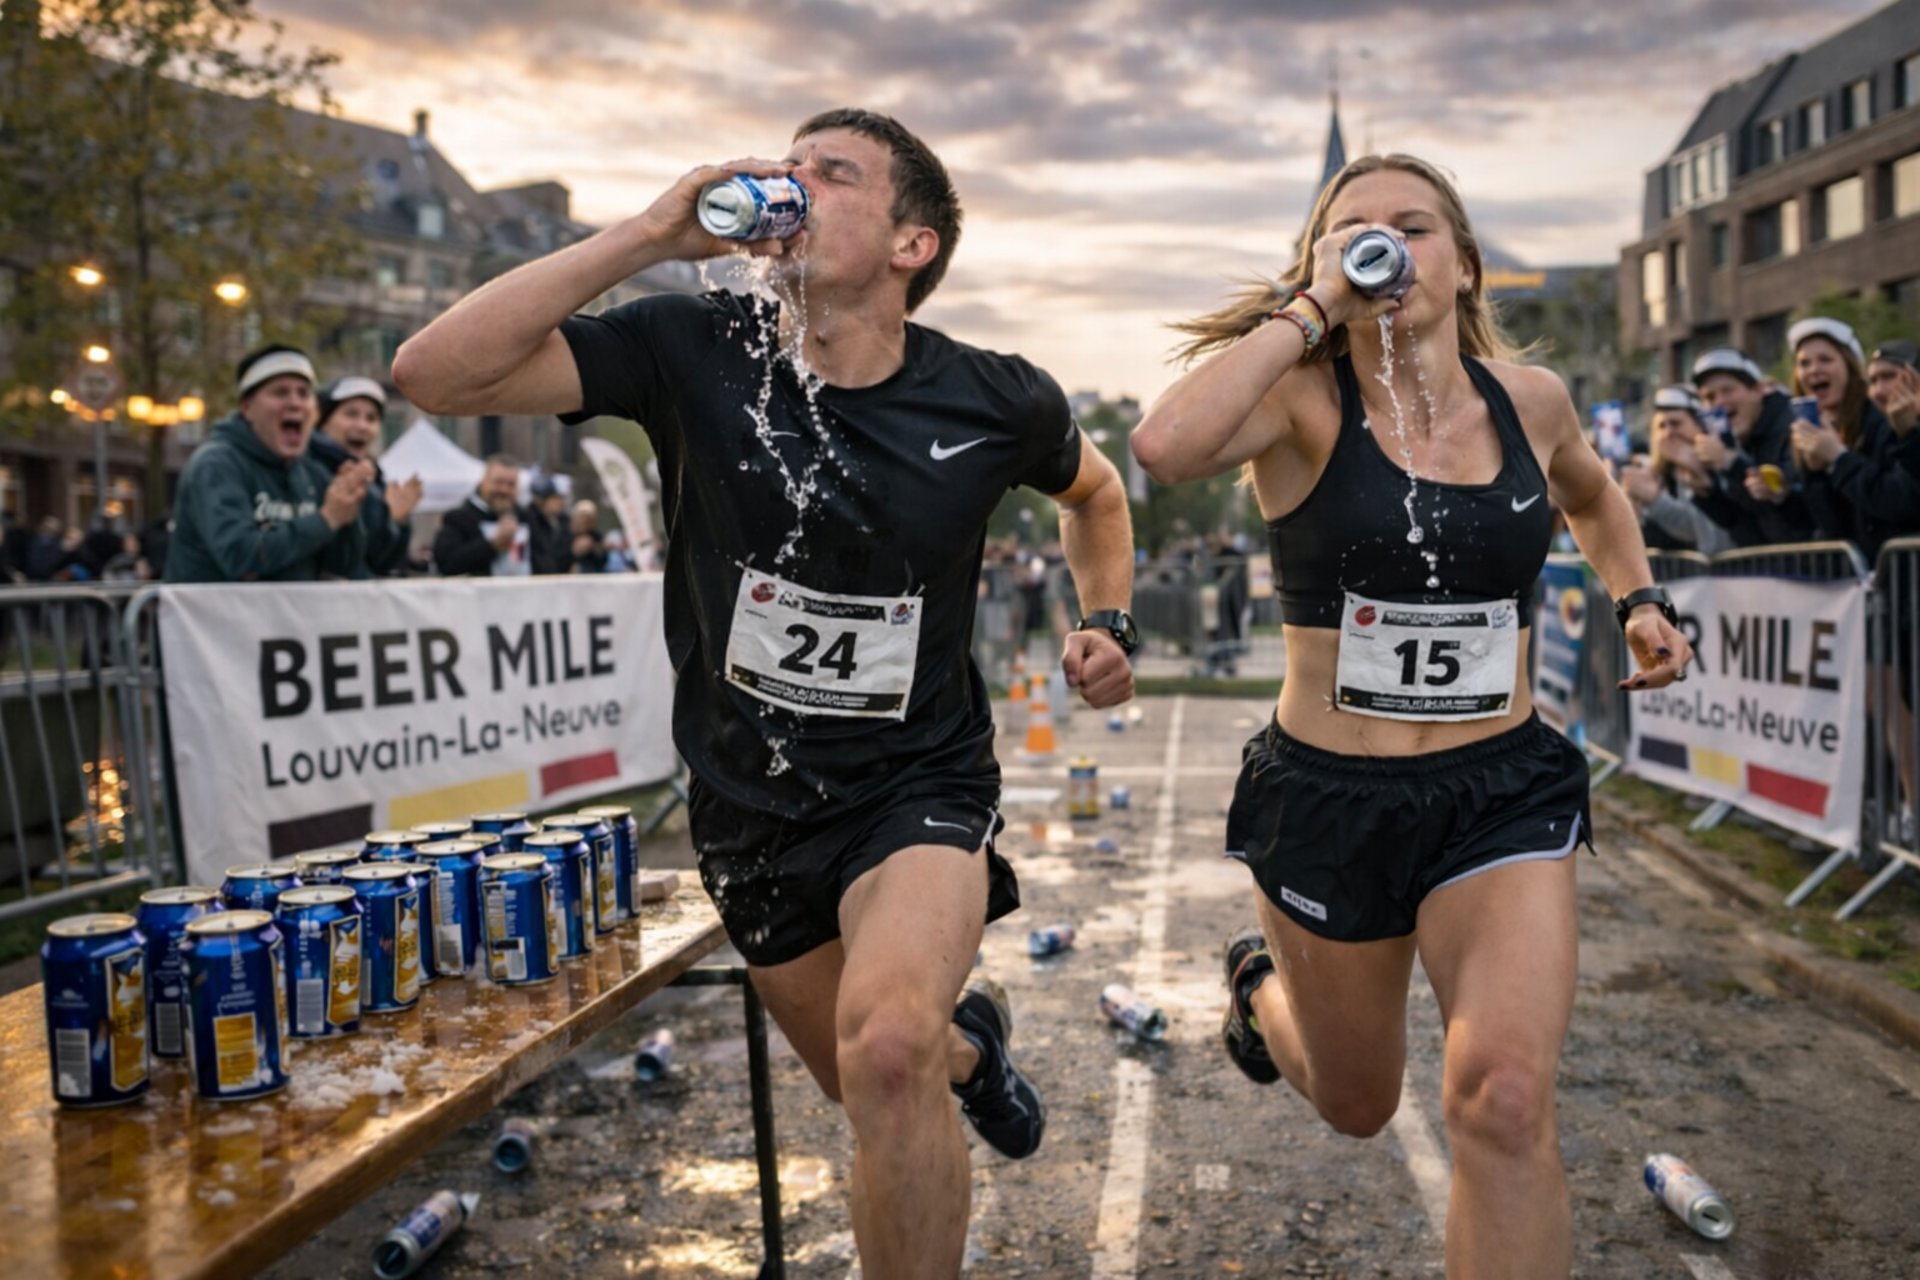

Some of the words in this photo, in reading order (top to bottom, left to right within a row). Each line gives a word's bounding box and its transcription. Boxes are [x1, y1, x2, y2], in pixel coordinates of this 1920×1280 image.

[259, 628, 467, 719] BEER
[486, 615, 615, 693] MILE
[778, 623, 857, 680] 24
[1394, 639, 1461, 687] 15
[261, 699, 622, 789] Louvain-La-Neuve
